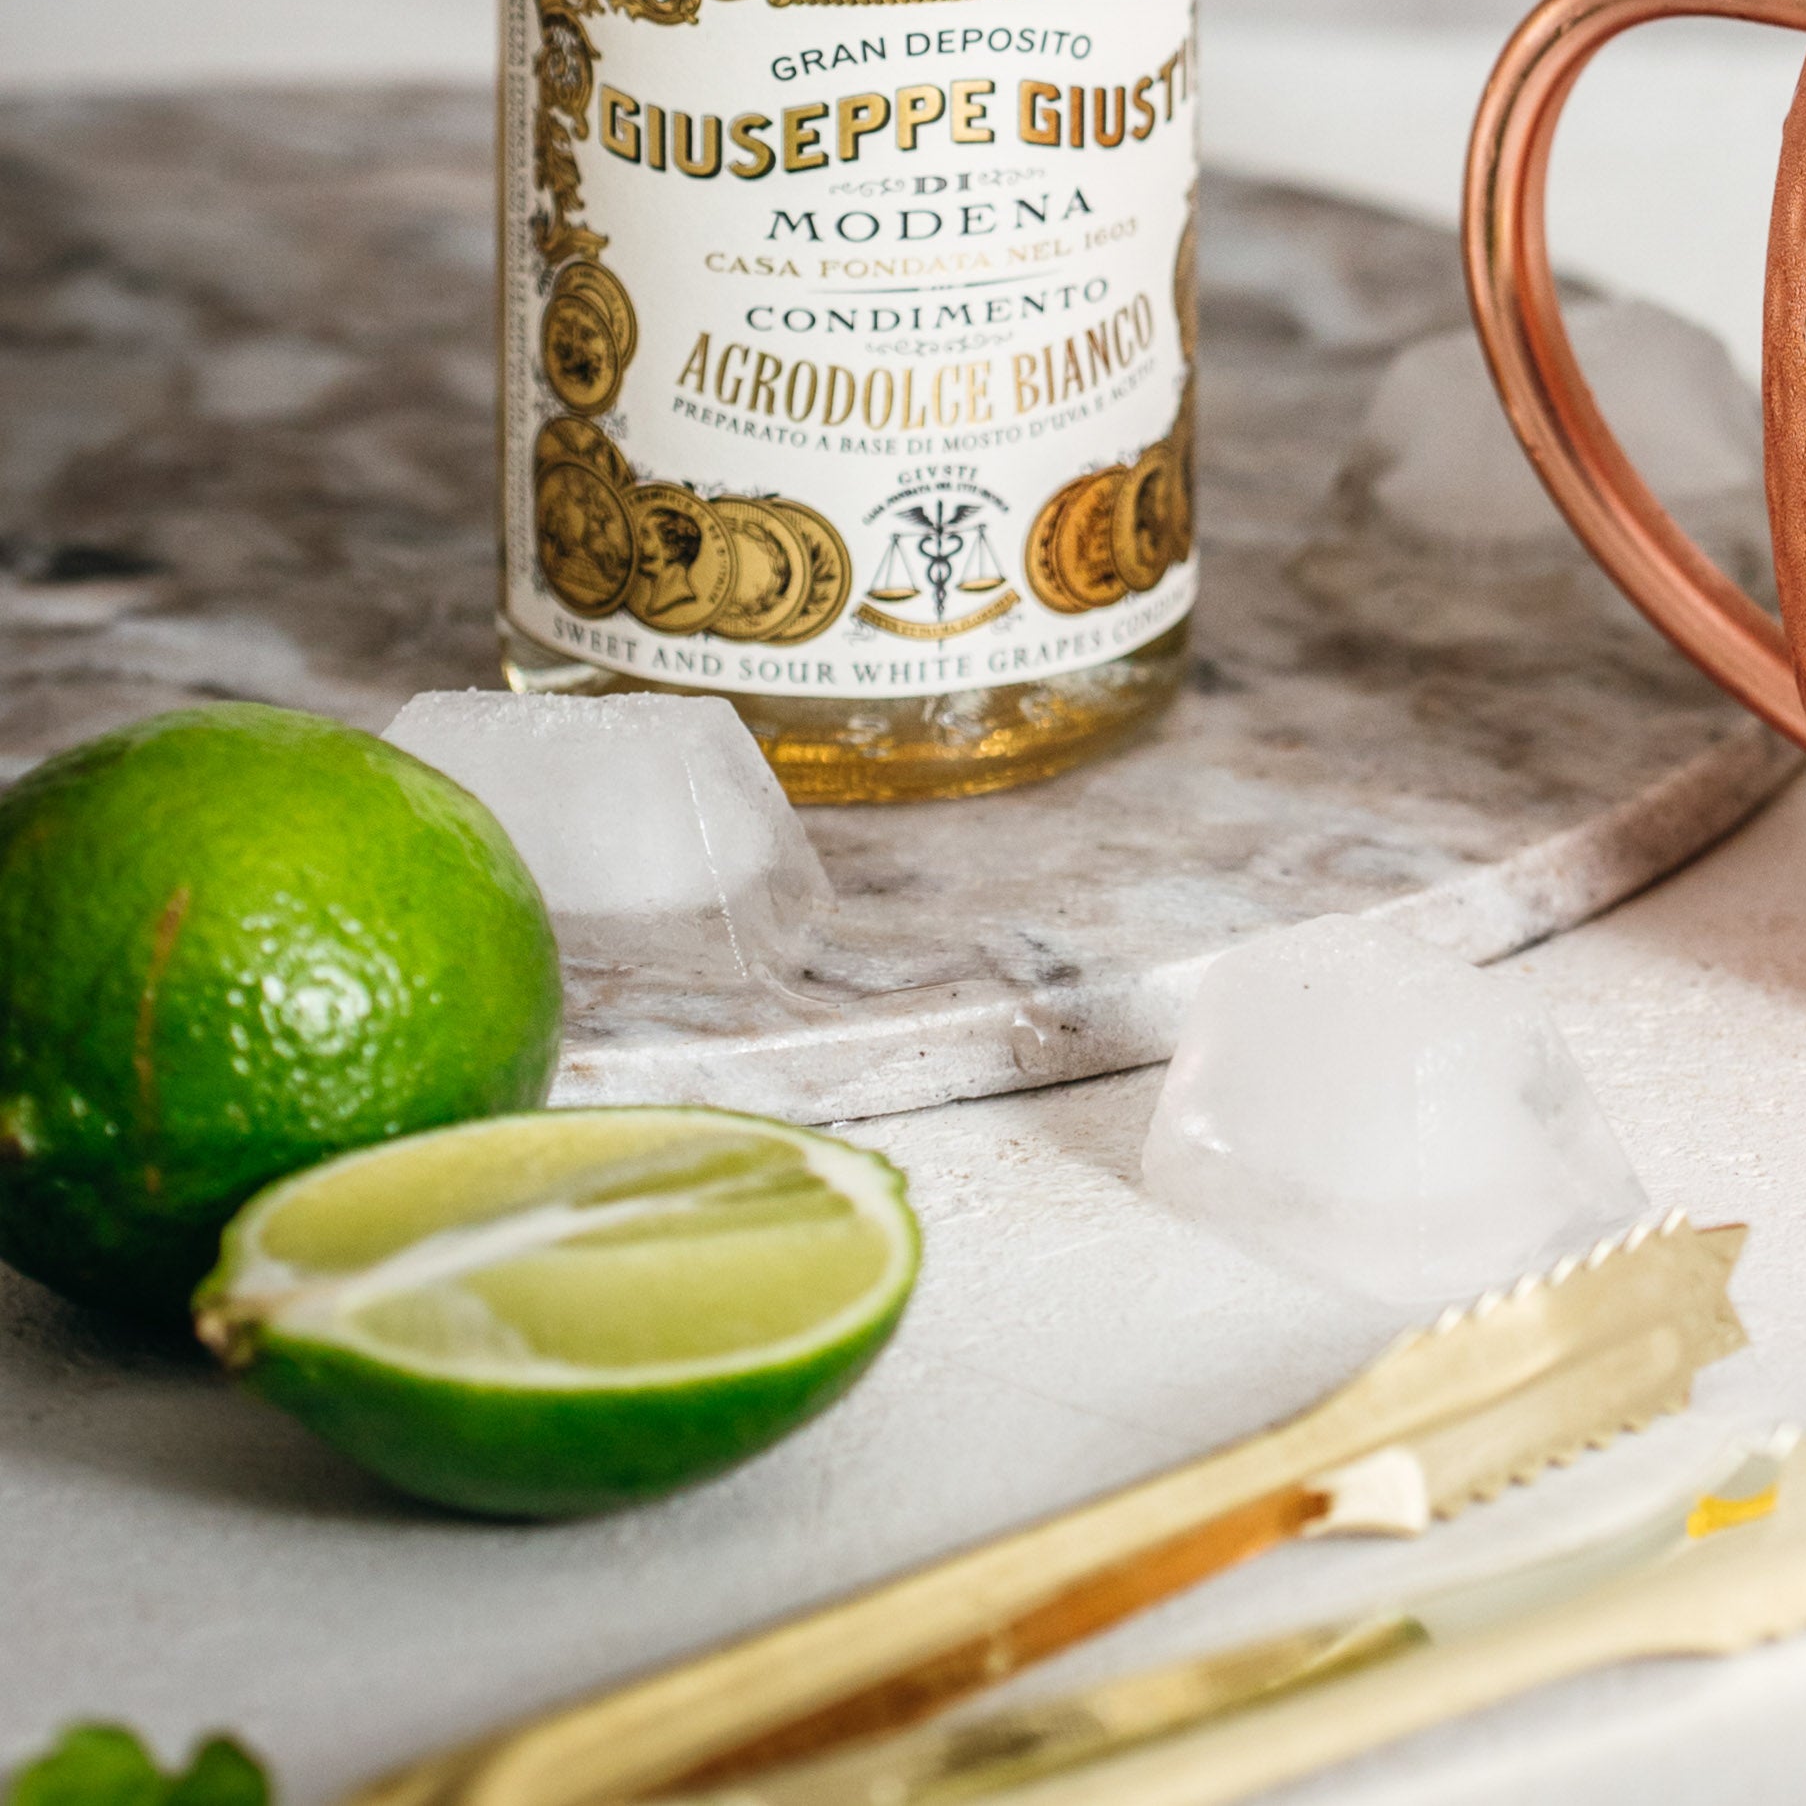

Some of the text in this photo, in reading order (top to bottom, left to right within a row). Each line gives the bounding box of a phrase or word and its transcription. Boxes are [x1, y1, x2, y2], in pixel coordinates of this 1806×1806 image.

[771, 27, 1093, 82] GRAN DEPOSITO
[598, 38, 1188, 180] GIUSEPPE GIUSTI
[912, 172, 972, 195] DI
[765, 186, 1094, 243] MODENA
[704, 217, 1139, 279] CASA FONDATA NEL 1605
[745, 278, 1109, 333] CONDIMENTO
[674, 290, 1155, 432] AGRODOLCE BIANCO
[671, 396, 809, 449] PREPARATO
[817, 435, 831, 452] A
[839, 436, 897, 456] BASE
[907, 437, 932, 456] DI
[941, 424, 1022, 453] MOSTO
[1029, 405, 1089, 438] D'UVA
[1094, 396, 1104, 413] E
[897, 465, 979, 485] GIVSTI
[551, 614, 637, 664] SWEET
[651, 648, 724, 678] AND
[738, 658, 837, 685] SOUR
[852, 655, 973, 685] WHITE
[987, 629, 1102, 674] GRAPES
